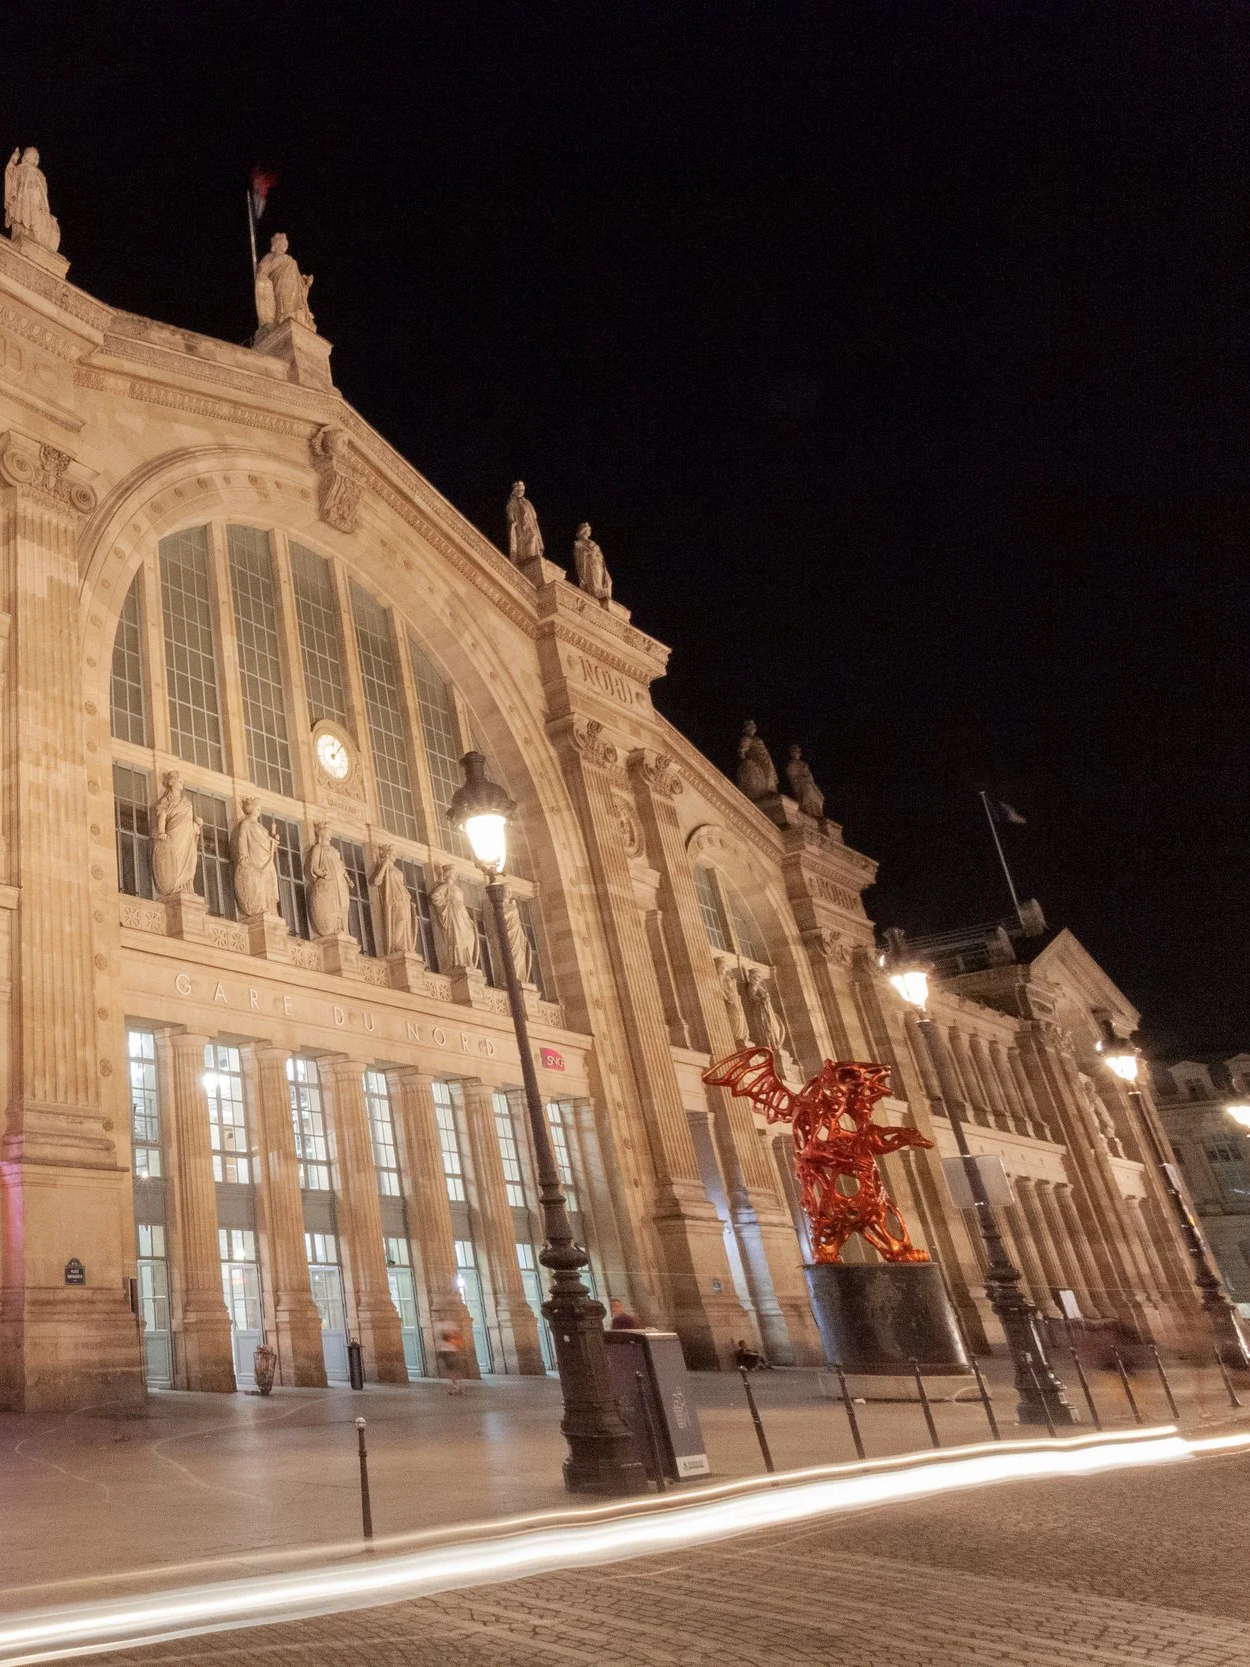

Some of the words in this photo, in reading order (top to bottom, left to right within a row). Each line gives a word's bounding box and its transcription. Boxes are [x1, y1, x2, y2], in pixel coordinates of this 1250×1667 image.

[175, 973, 295, 1017] GARE
[333, 1005, 375, 1033] DU
[406, 1020, 495, 1057] NORD
